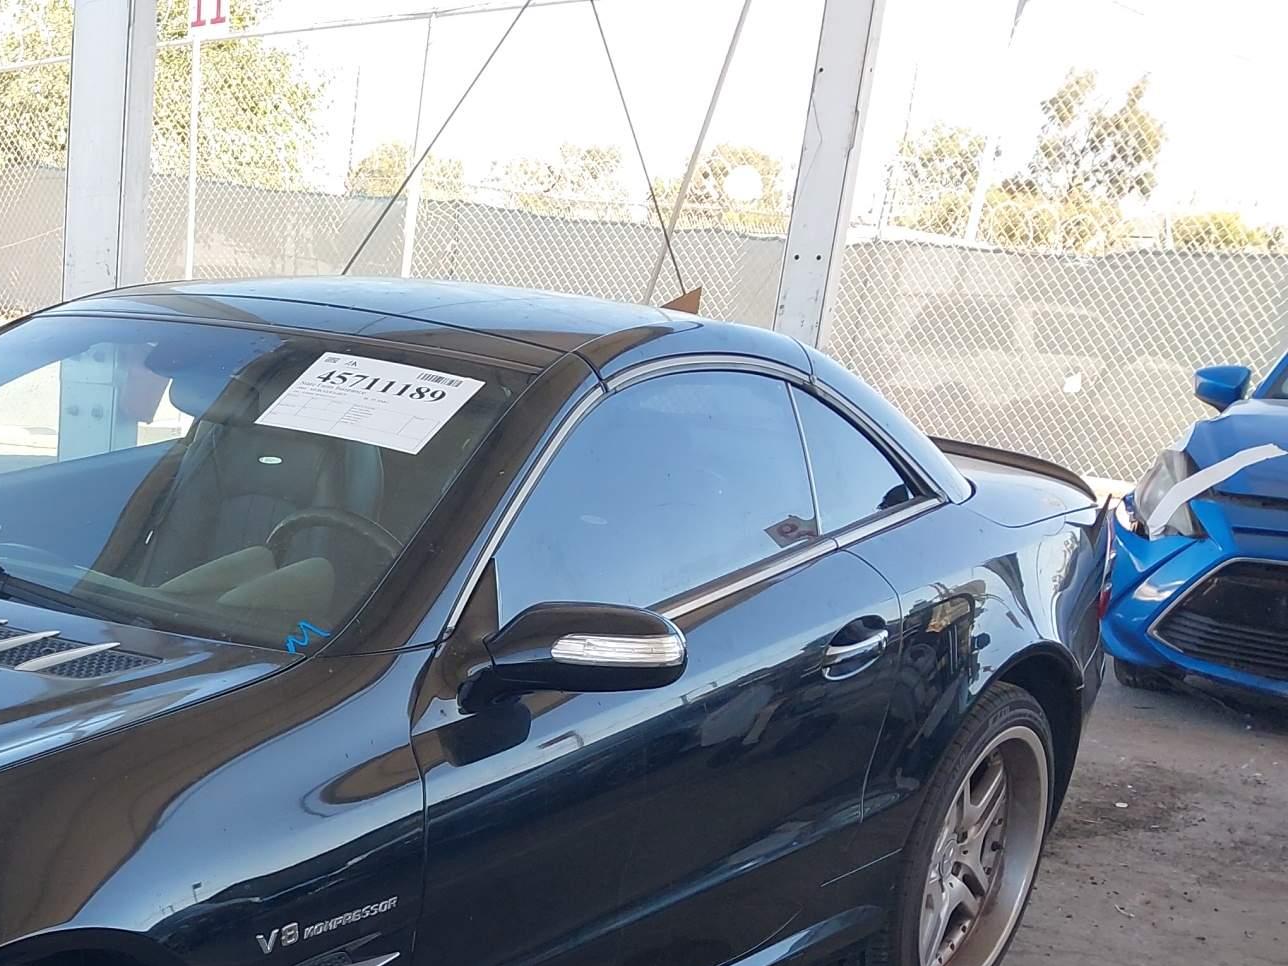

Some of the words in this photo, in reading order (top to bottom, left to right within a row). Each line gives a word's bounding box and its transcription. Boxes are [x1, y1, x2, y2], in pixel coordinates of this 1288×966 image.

[191, 0, 226, 28] 11
[316, 370, 445, 402] 45711189
[256, 922, 299, 953] V8
[303, 896, 398, 939] KOMPRESSOR
